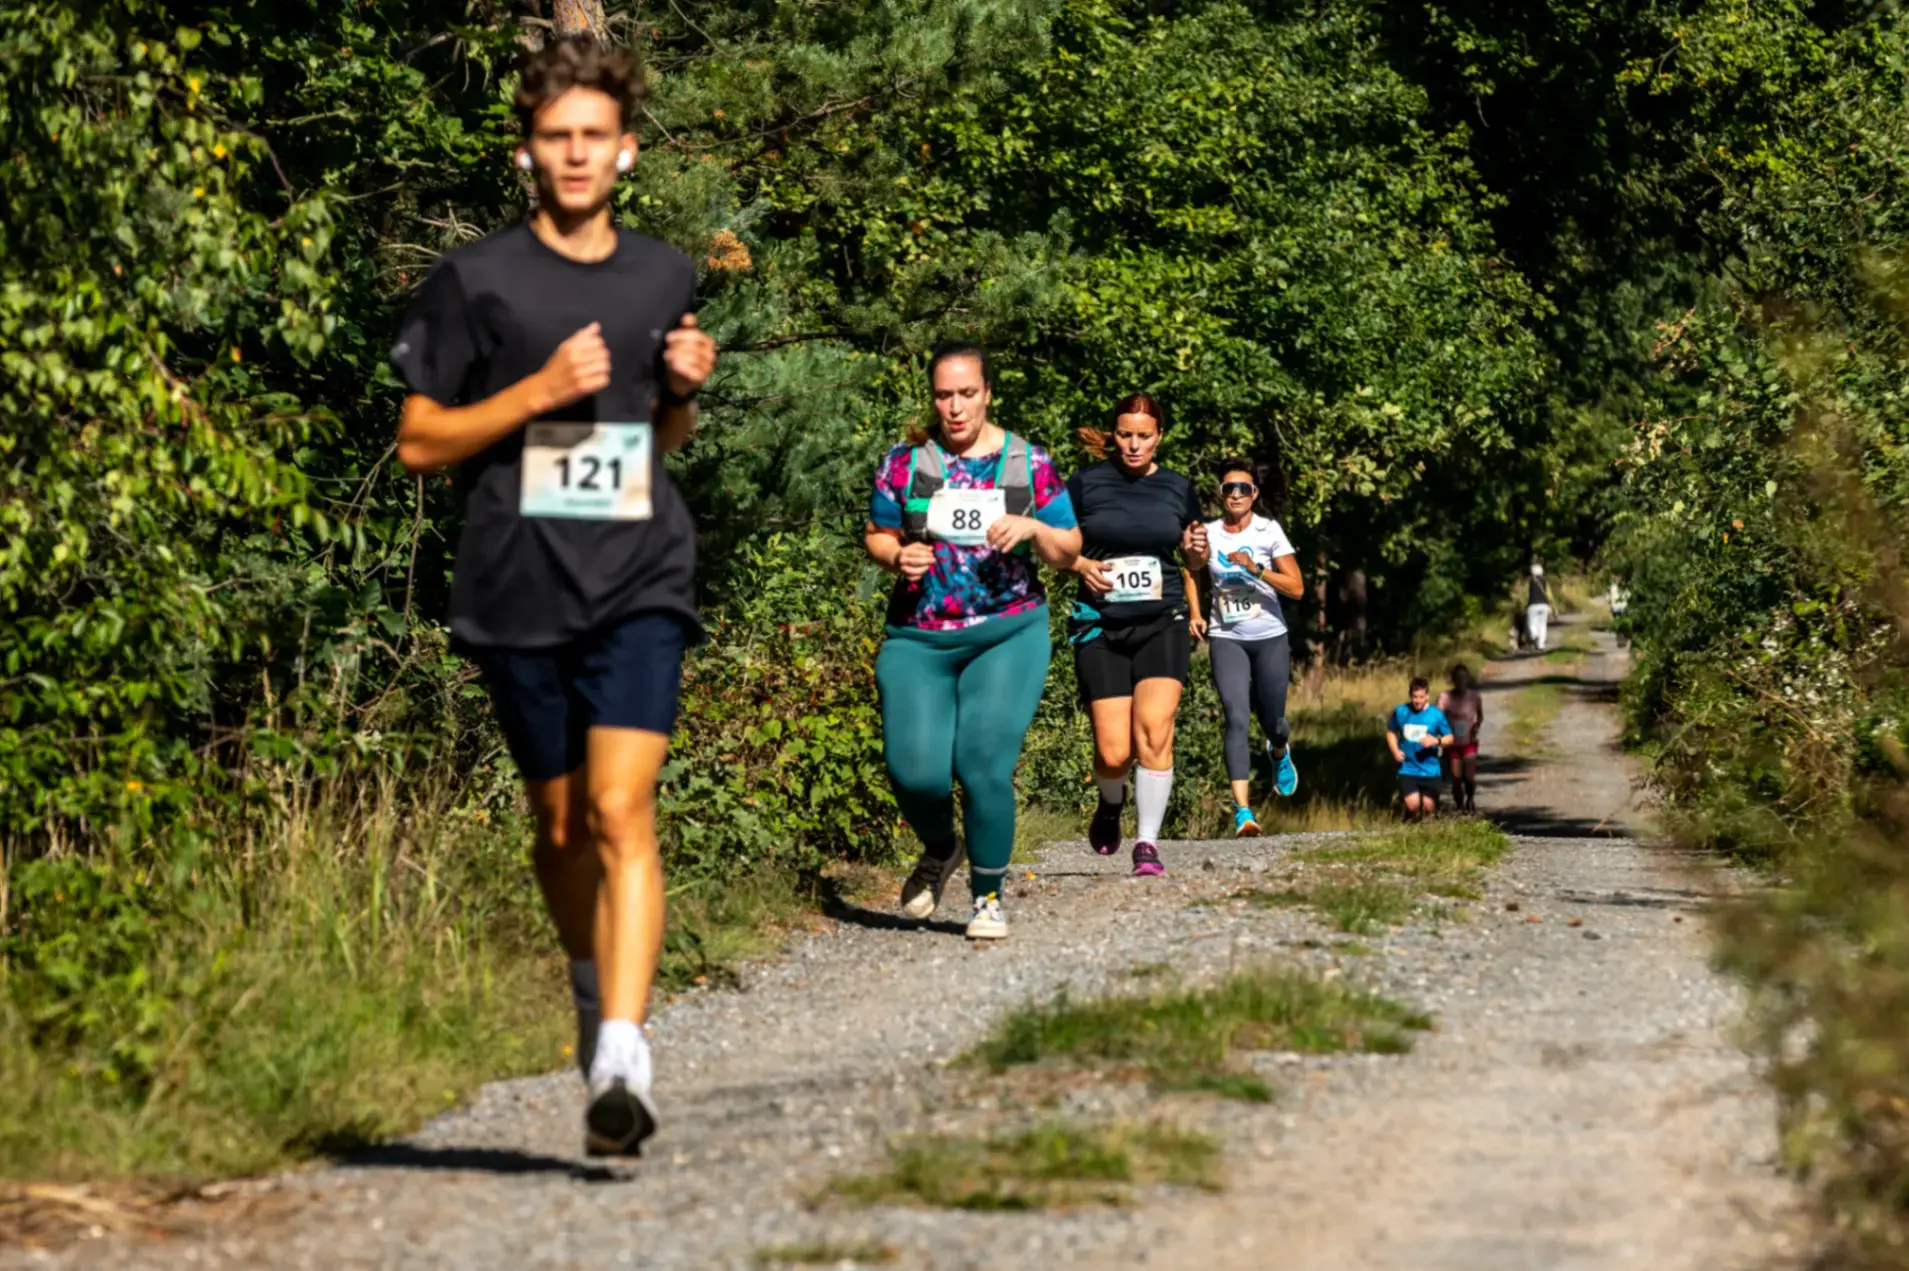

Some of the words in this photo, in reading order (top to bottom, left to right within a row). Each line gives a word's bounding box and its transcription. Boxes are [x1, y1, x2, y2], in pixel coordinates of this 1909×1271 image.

[553, 456, 621, 490] 121
[952, 509, 982, 530] 88
[1116, 571, 1152, 589] 105
[1223, 597, 1251, 613] 116
